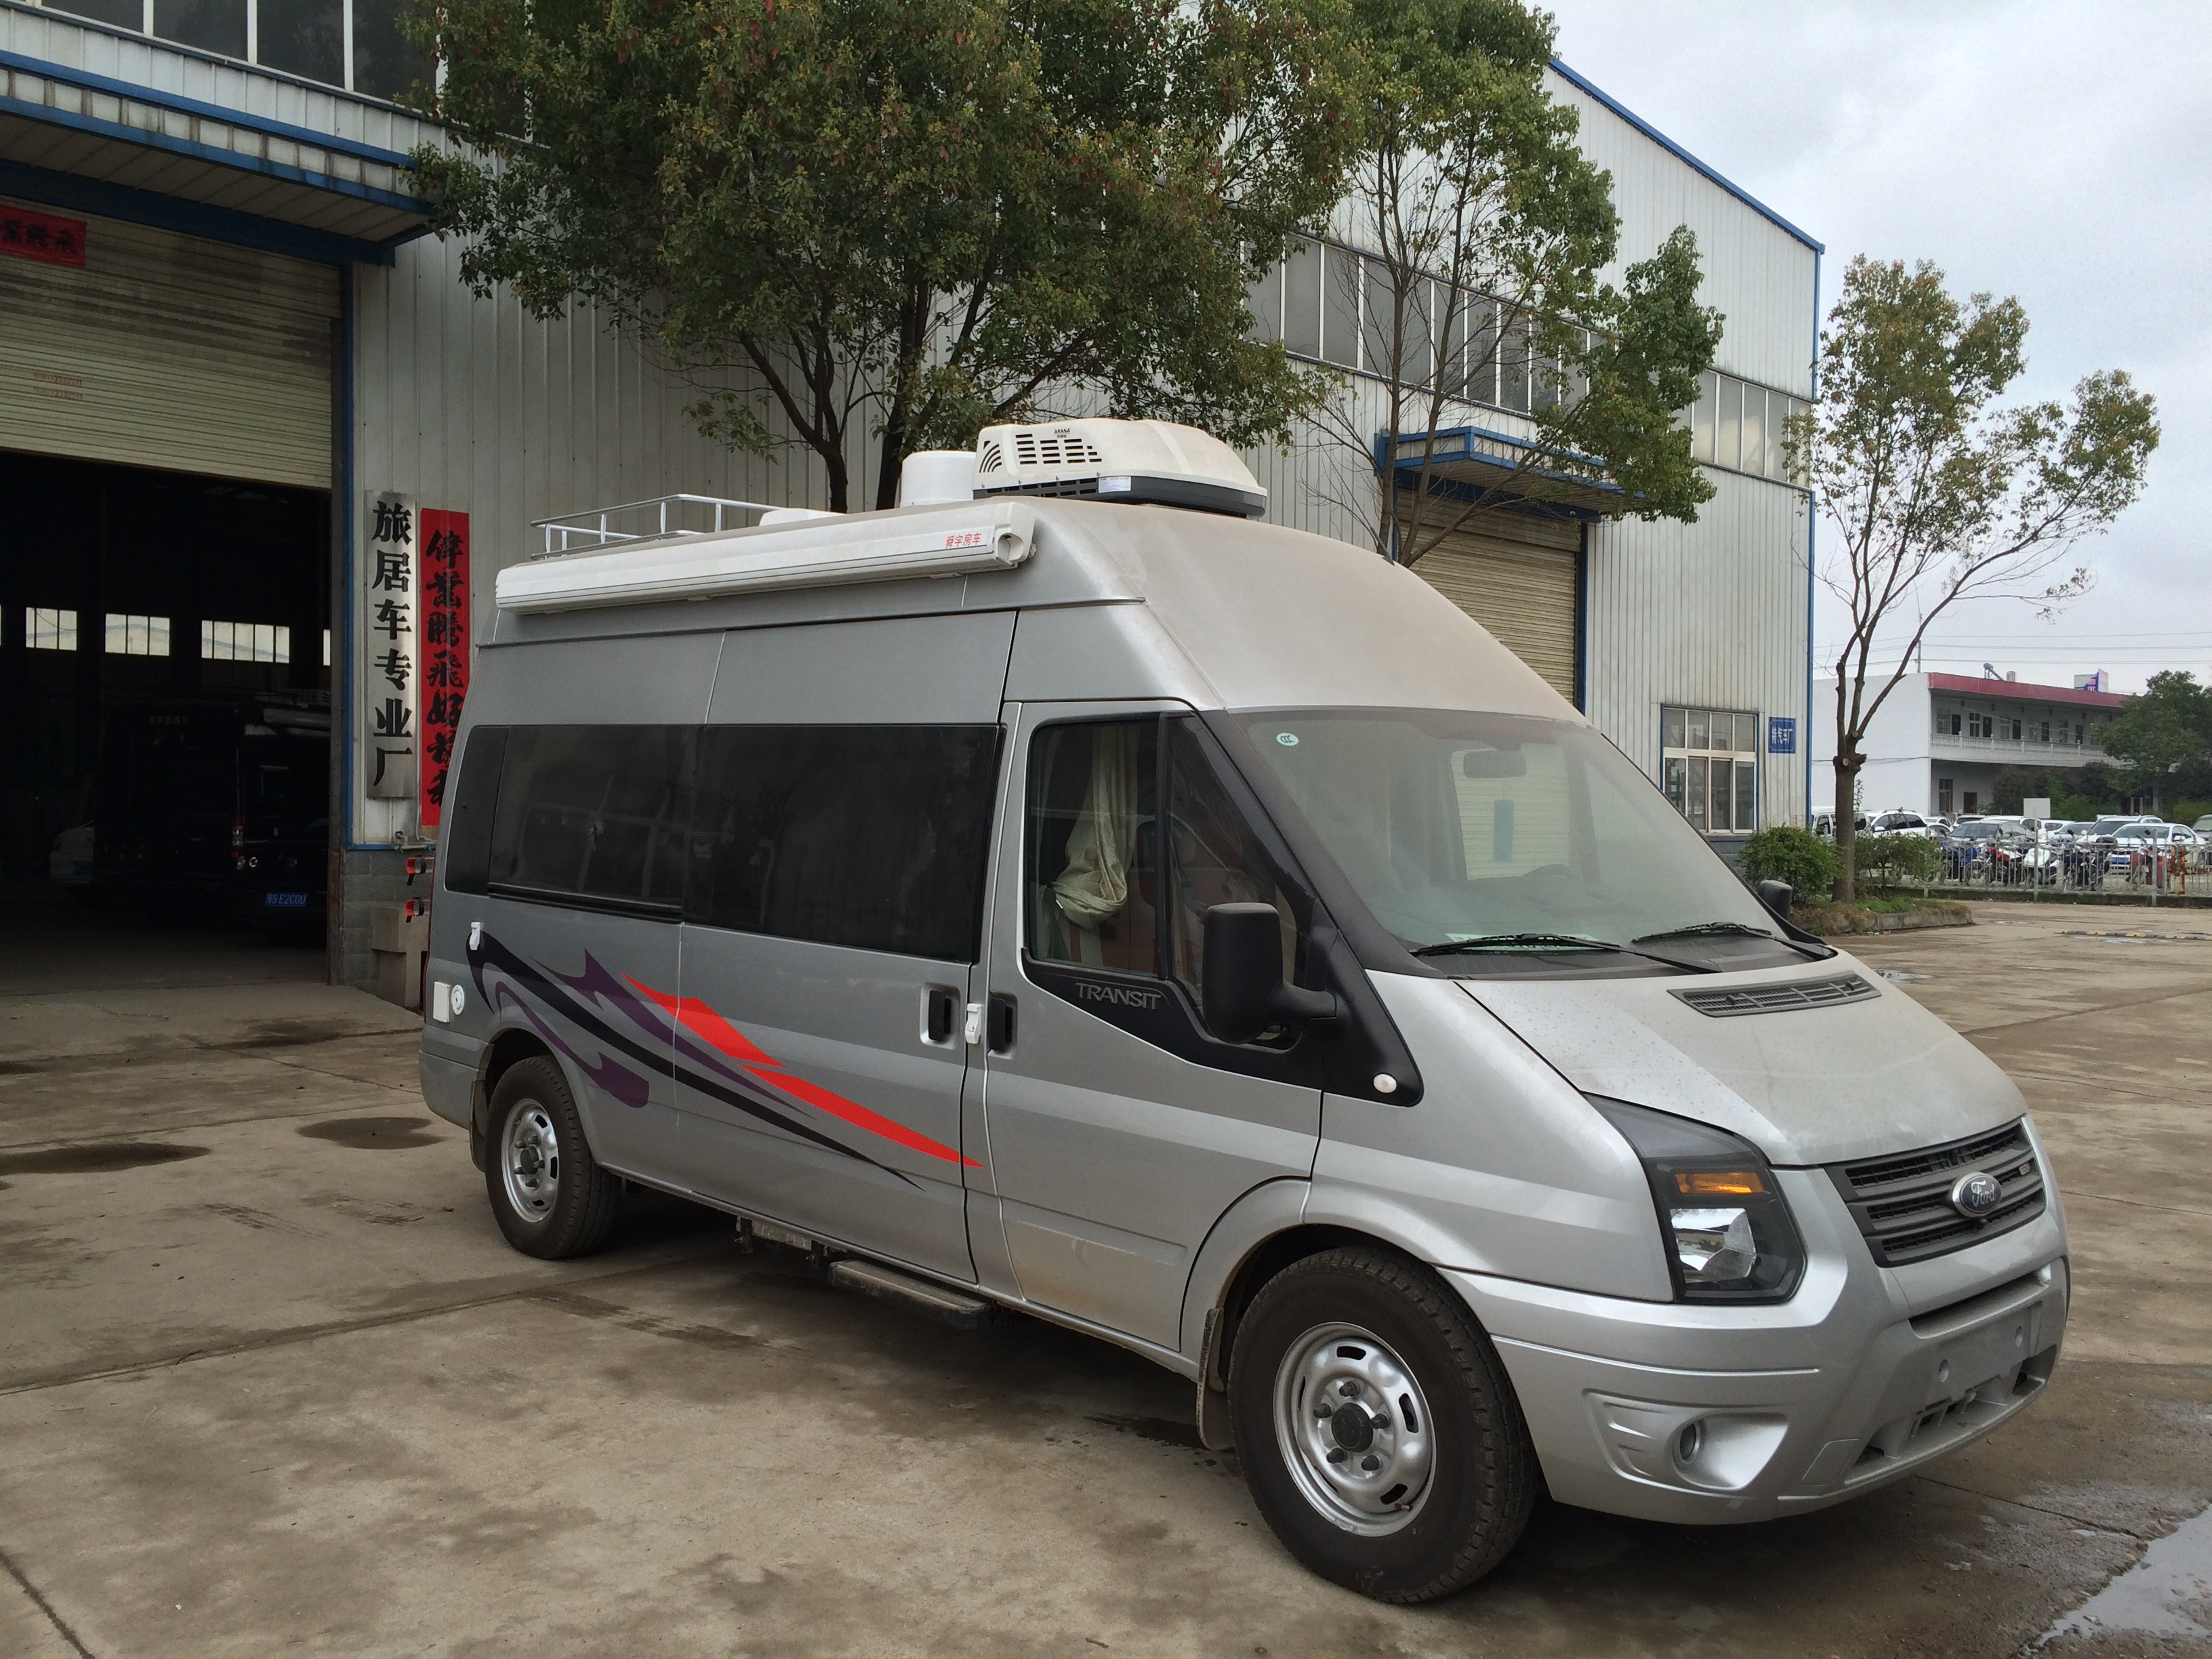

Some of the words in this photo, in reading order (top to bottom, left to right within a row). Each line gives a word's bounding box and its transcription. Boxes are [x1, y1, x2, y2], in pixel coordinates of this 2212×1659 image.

[945, 532, 982, 549] 舜宇房车
[371, 501, 413, 786] 旅居车专业厂
[1076, 983, 1162, 1010] TRANSIT
[1971, 1180, 1996, 1207] Ford
